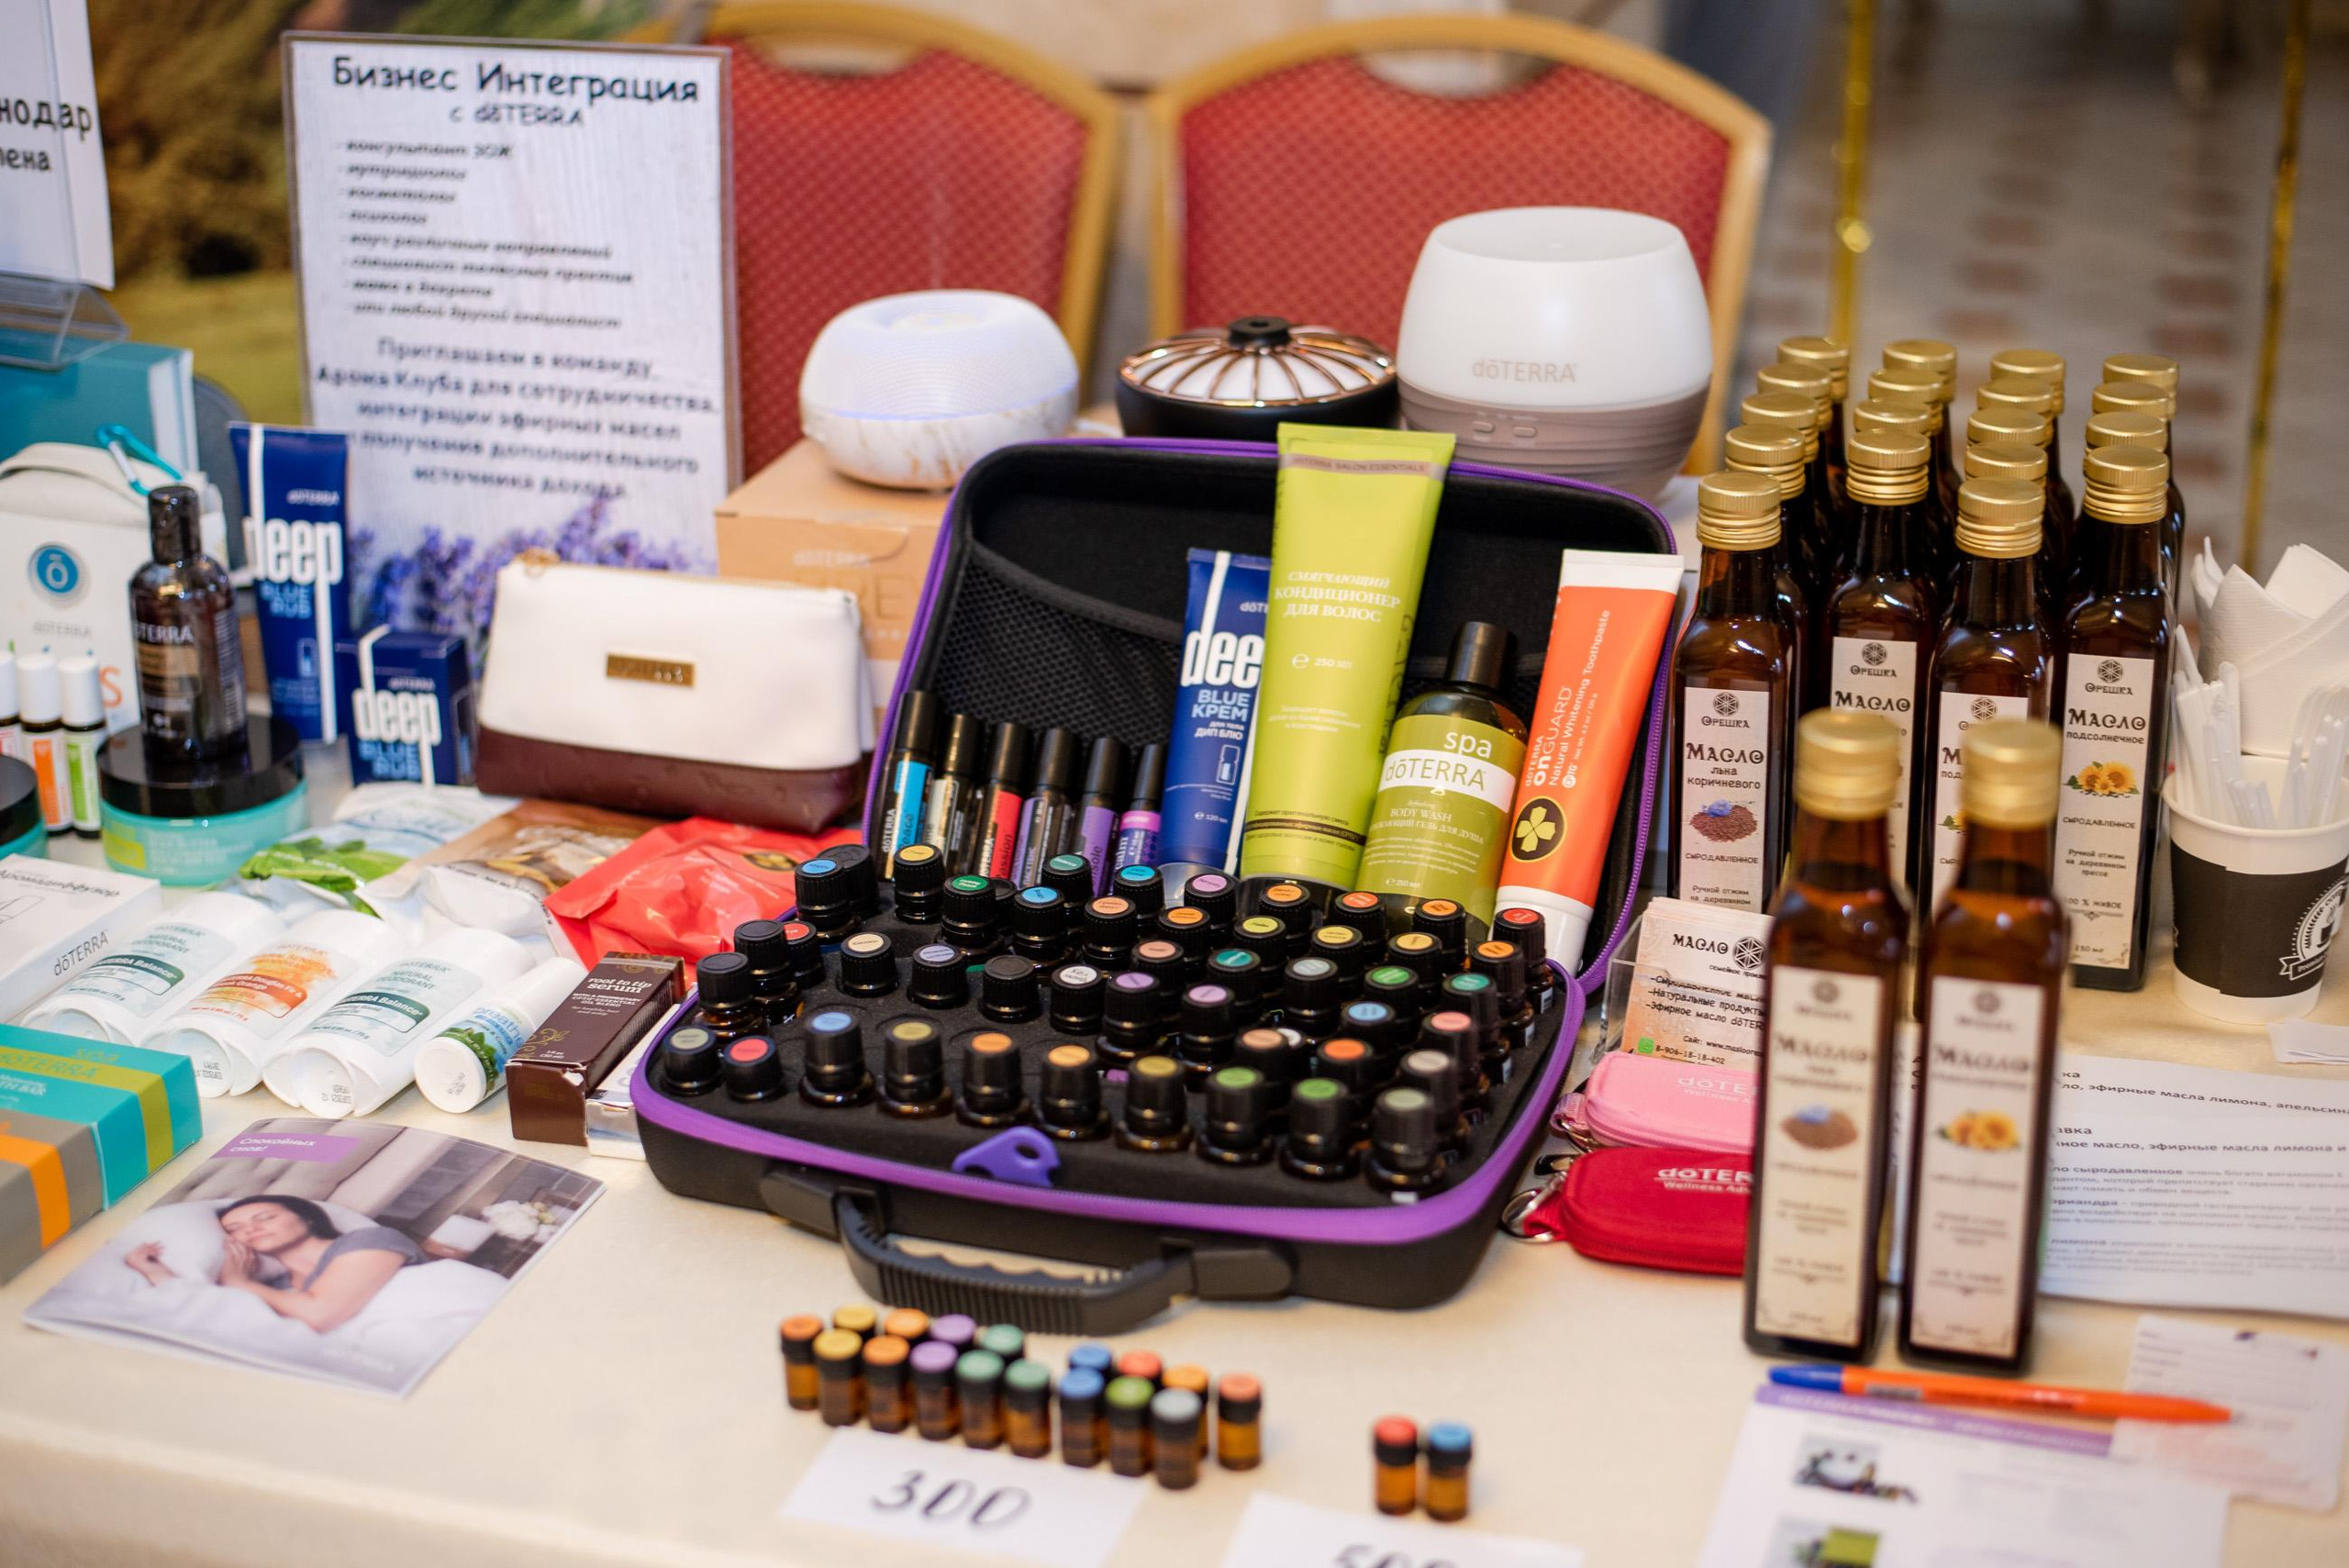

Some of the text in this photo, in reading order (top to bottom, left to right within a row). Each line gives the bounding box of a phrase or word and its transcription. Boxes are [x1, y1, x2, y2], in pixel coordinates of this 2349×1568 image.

[333, 57, 698, 106] Бизнес Интеграция
[395, 369, 463, 395] Клуба
[470, 378, 511, 397] для
[489, 440, 698, 474] дополнительного
[1275, 586, 1401, 608] КОНДИЦИОНЕР
[1283, 602, 1384, 622] ДЛЯ ВОЛОС
[1197, 689, 1252, 709] BLUE
[1549, 609, 1610, 786] Natural Whitening Toothpaste
[1191, 704, 1249, 722] КРЕМ
[1194, 728, 1244, 740] ДИП БЛЮ
[2066, 731, 2145, 745] подсолнечное
[1443, 731, 1492, 760] spa
[1709, 767, 1738, 776] льна
[1687, 776, 1762, 790] коричневого
[1390, 807, 1453, 824] BODY WASH
[587, 983, 642, 994] serum
[632, 981, 652, 989] tip
[378, 996, 424, 1017] Balance
[1696, 1012, 1727, 1023] масло
[2088, 1084, 2156, 1096] эфирные
[2160, 1090, 2205, 1101] масла
[2210, 1096, 2272, 1108] лимона,
[239, 1138, 317, 1148] Спокойных
[2093, 1141, 2145, 1151] масло,
[2149, 1142, 2218, 1152] эфирные
[2222, 1144, 2269, 1153] масла
[2273, 1145, 2333, 1153] лимона
[2073, 1166, 2184, 1176] сыродавленное
[1664, 1180, 1723, 1192] Wellness
[871, 1468, 1031, 1530] 300
